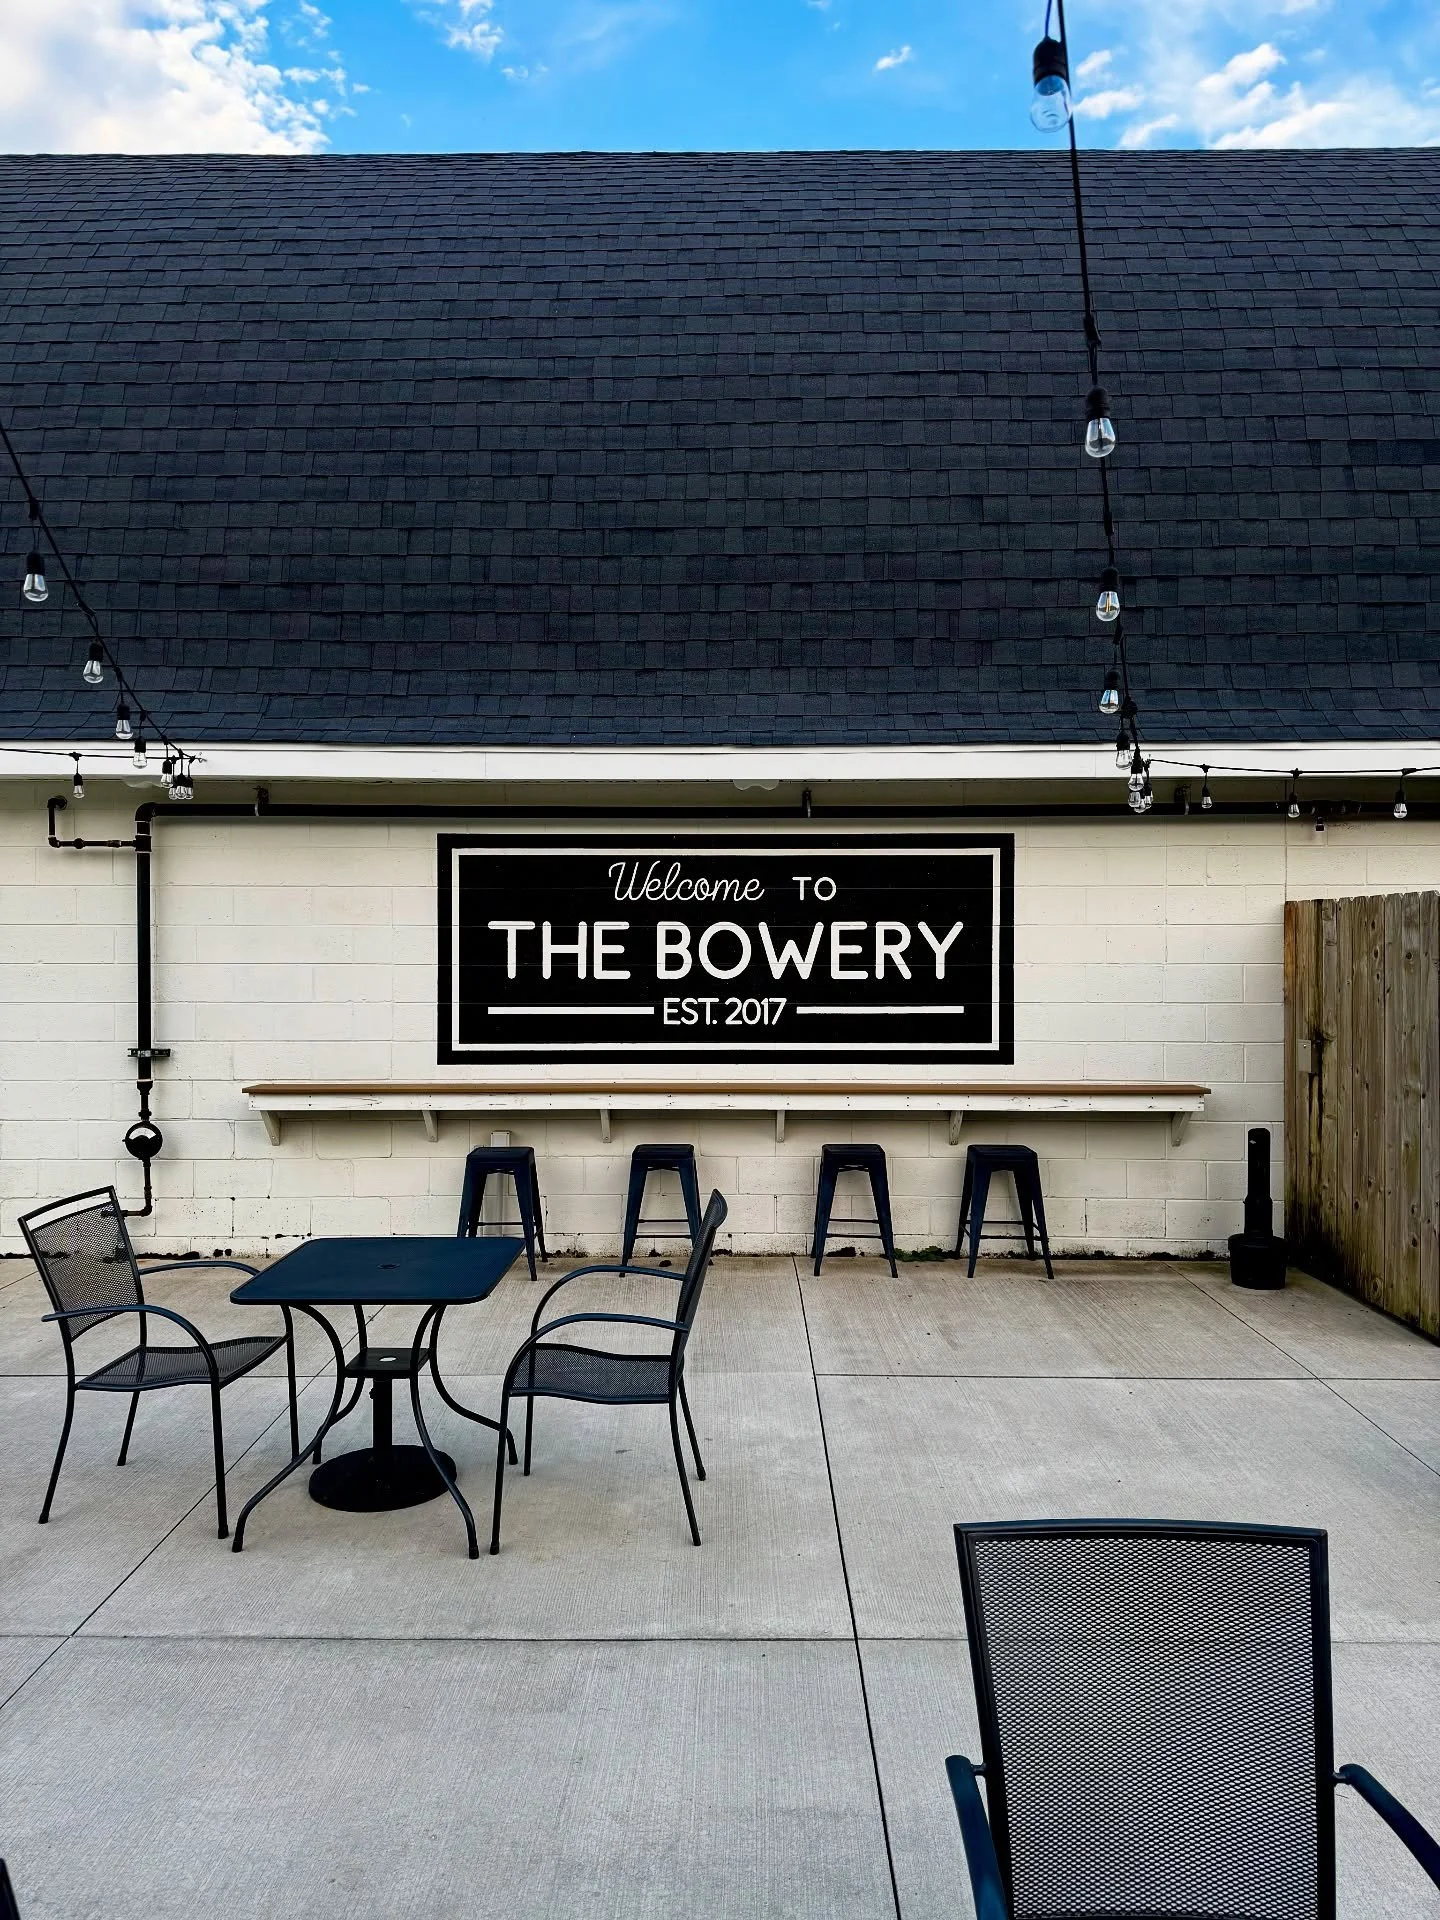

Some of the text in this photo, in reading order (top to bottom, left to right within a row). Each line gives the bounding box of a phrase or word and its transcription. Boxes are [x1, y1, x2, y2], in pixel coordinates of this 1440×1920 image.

[607, 860, 837, 902] Welcome TO
[487, 920, 965, 980] THE BOWERY
[663, 996, 788, 1025] EST. 2017
